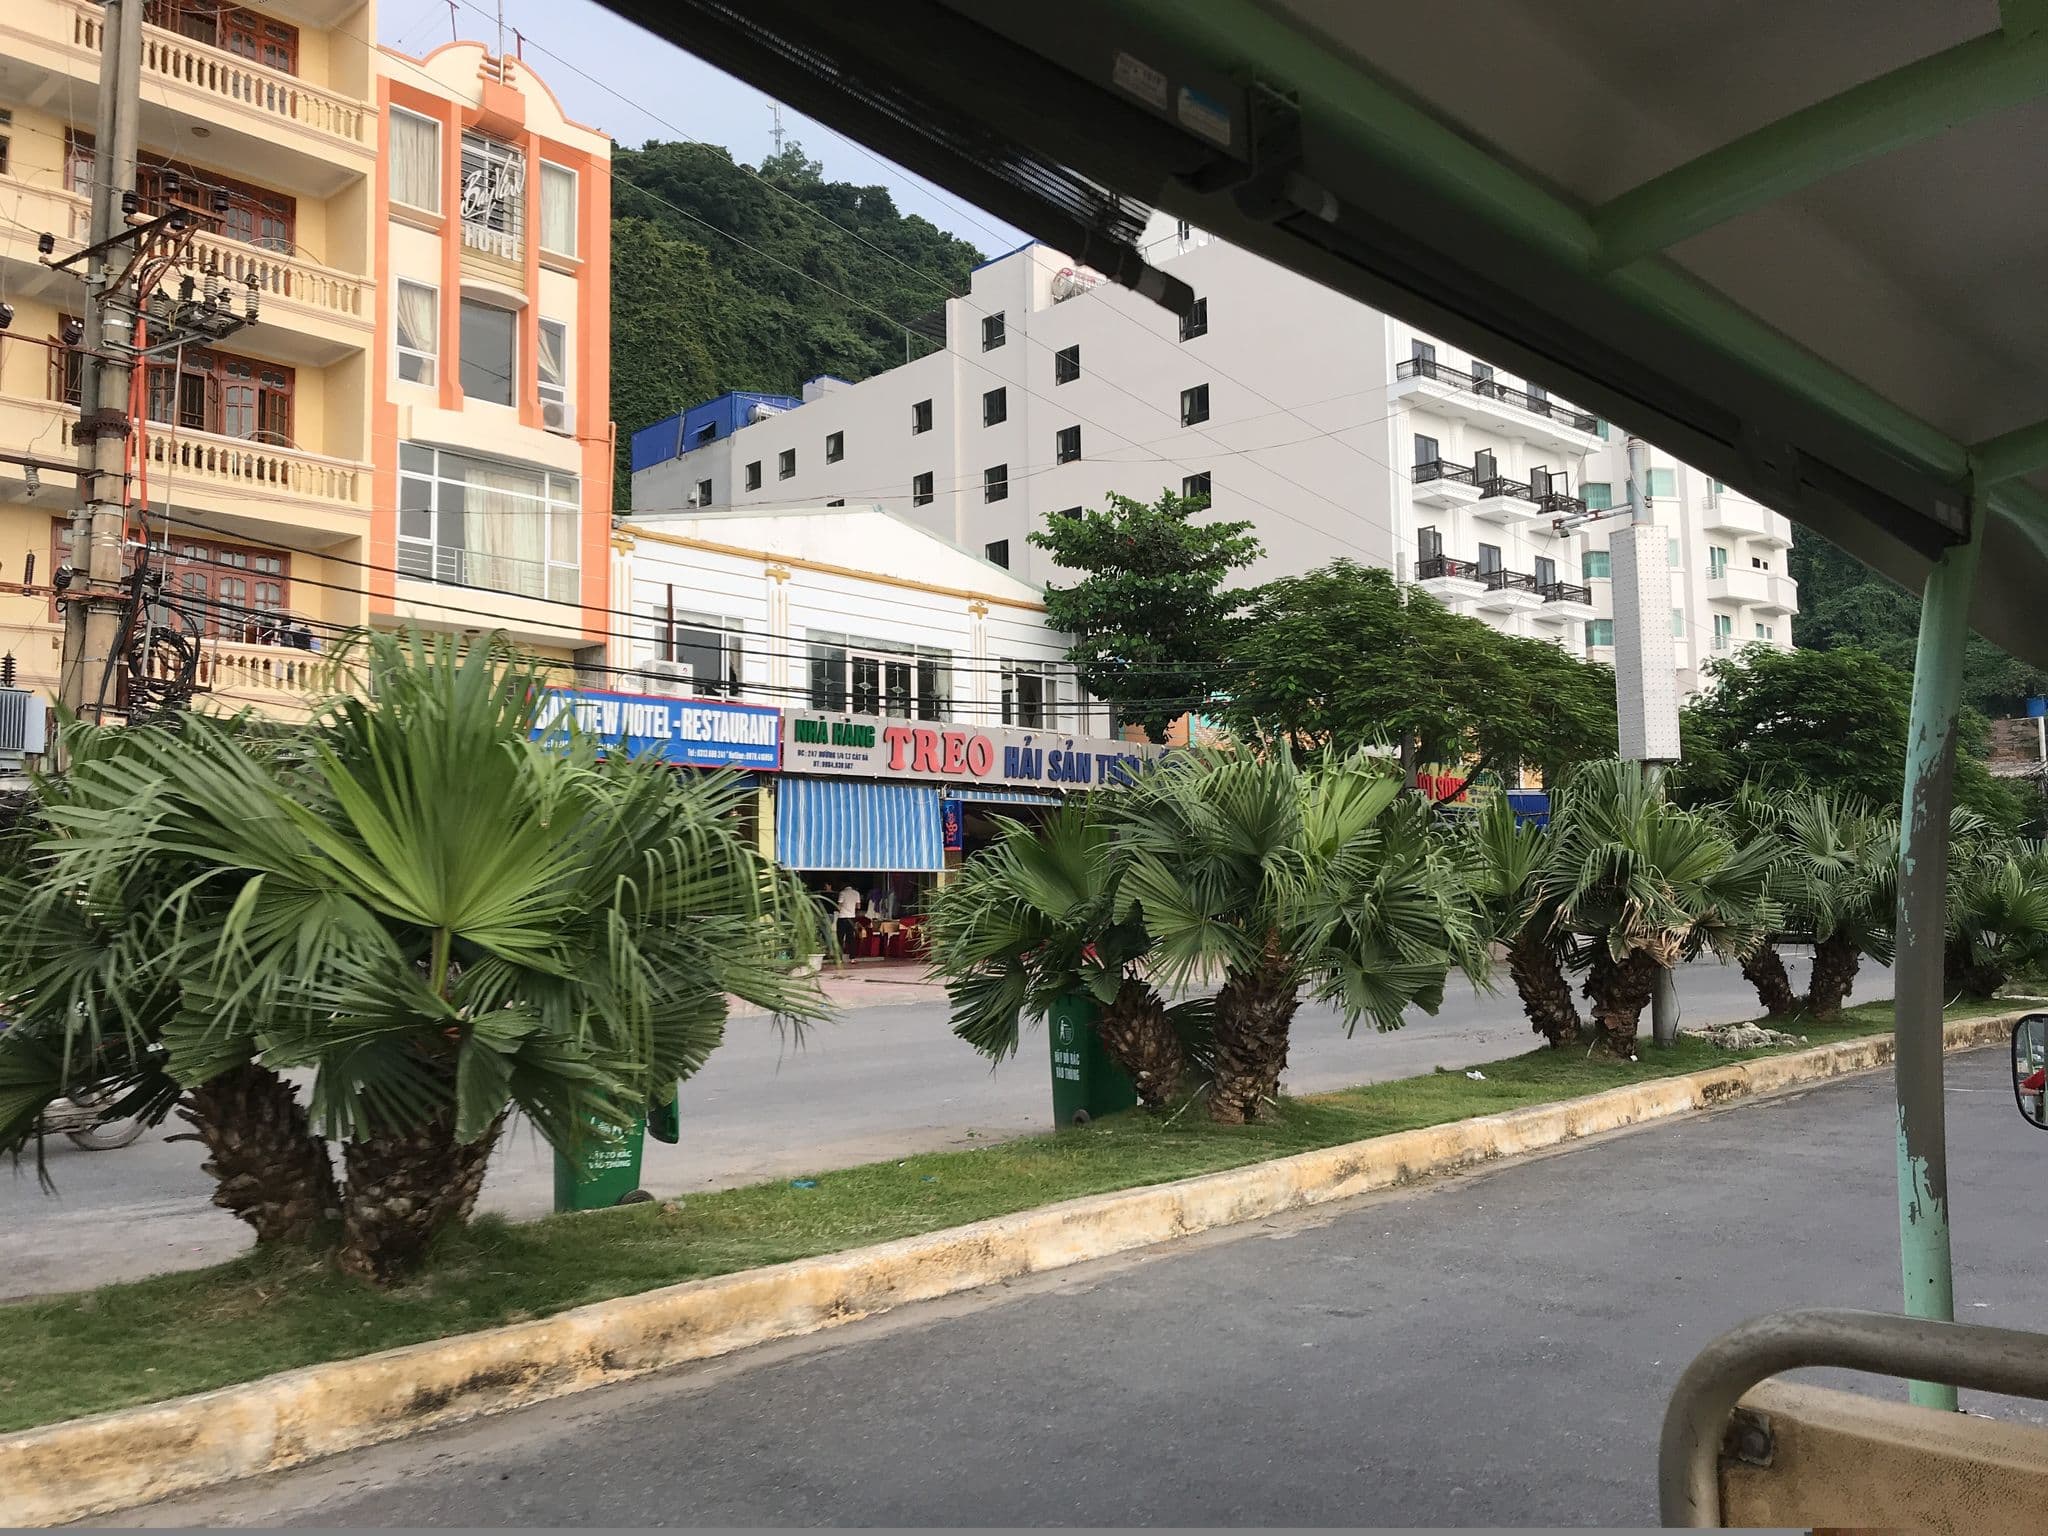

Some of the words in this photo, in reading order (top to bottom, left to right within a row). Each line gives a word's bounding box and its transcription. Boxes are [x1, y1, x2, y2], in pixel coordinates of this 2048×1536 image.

[465, 224, 522, 262] HOTEL
[573, 698, 620, 735] VIEW
[680, 707, 778, 746] RESTAURANT
[794, 715, 829, 745] NHÀ
[832, 718, 876, 749] HÀNG
[884, 726, 994, 777] TREO
[1004, 735, 1043, 780] HẢI
[1048, 739, 1092, 784] SẢN
